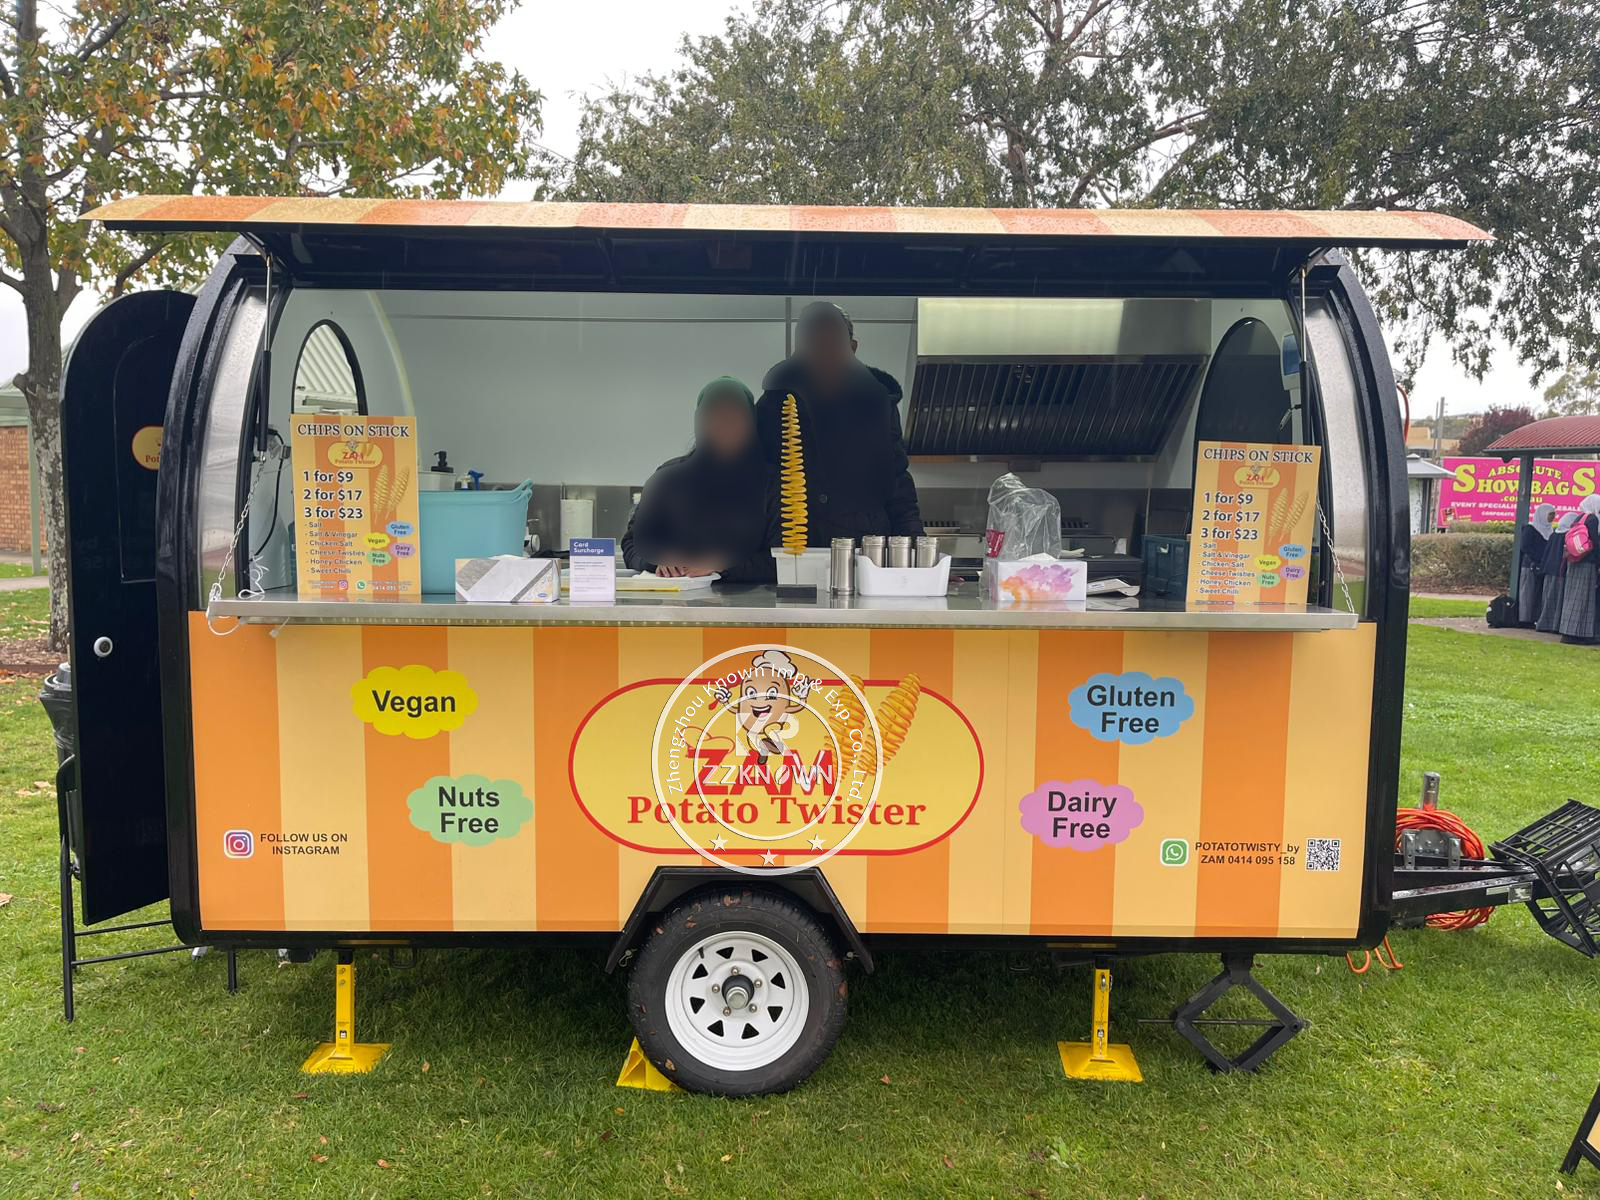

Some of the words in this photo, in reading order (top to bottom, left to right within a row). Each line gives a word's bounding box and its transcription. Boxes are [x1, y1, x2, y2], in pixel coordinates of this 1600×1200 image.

[298, 424, 340, 435] CHIPS
[344, 425, 364, 435] ON
[368, 425, 410, 437] STICK
[1203, 448, 1245, 460] CHIPS
[1249, 450, 1269, 461] ON
[1272, 452, 1313, 463] STICK
[303, 471, 310, 481] 1
[314, 470, 334, 481] for
[337, 471, 354, 483] $9
[303, 489, 311, 500] 2
[315, 489, 334, 500] for
[338, 489, 363, 501] $17
[1204, 493, 1210, 502] 1
[1215, 492, 1234, 503] for
[1237, 494, 1253, 504] $9
[304, 507, 312, 517] 3
[316, 507, 335, 518] for
[338, 508, 363, 519] $23
[1202, 510, 1210, 520] 2
[1213, 510, 1232, 521] for
[1236, 512, 1260, 523] $17
[1201, 528, 1208, 538] 3
[1212, 527, 1231, 539] for
[1234, 529, 1258, 540] $23
[573, 547, 604, 555] Surcharge
[310, 558, 332, 566] Honey
[1087, 685, 1175, 707] Gluten
[371, 690, 456, 718] Vegan
[1101, 711, 1159, 733] Free
[684, 749, 838, 796] ZAM
[438, 786, 500, 807] Nuts
[627, 796, 759, 825] Potato
[770, 796, 927, 826] Twister
[1048, 791, 1118, 818] Dairy
[440, 812, 499, 833] Free
[1053, 817, 1111, 838] Free
[260, 833, 309, 842] FOLLOW
[312, 833, 328, 842] US
[331, 833, 348, 842] ON
[272, 846, 340, 855] INSTAGRAM
[1195, 842, 1300, 854] POTATOTWISTY_by
[1201, 855, 1225, 864] ZAM
[1228, 855, 1253, 864] 0414
[1255, 856, 1274, 865] 095
[1278, 856, 1295, 865] 158
